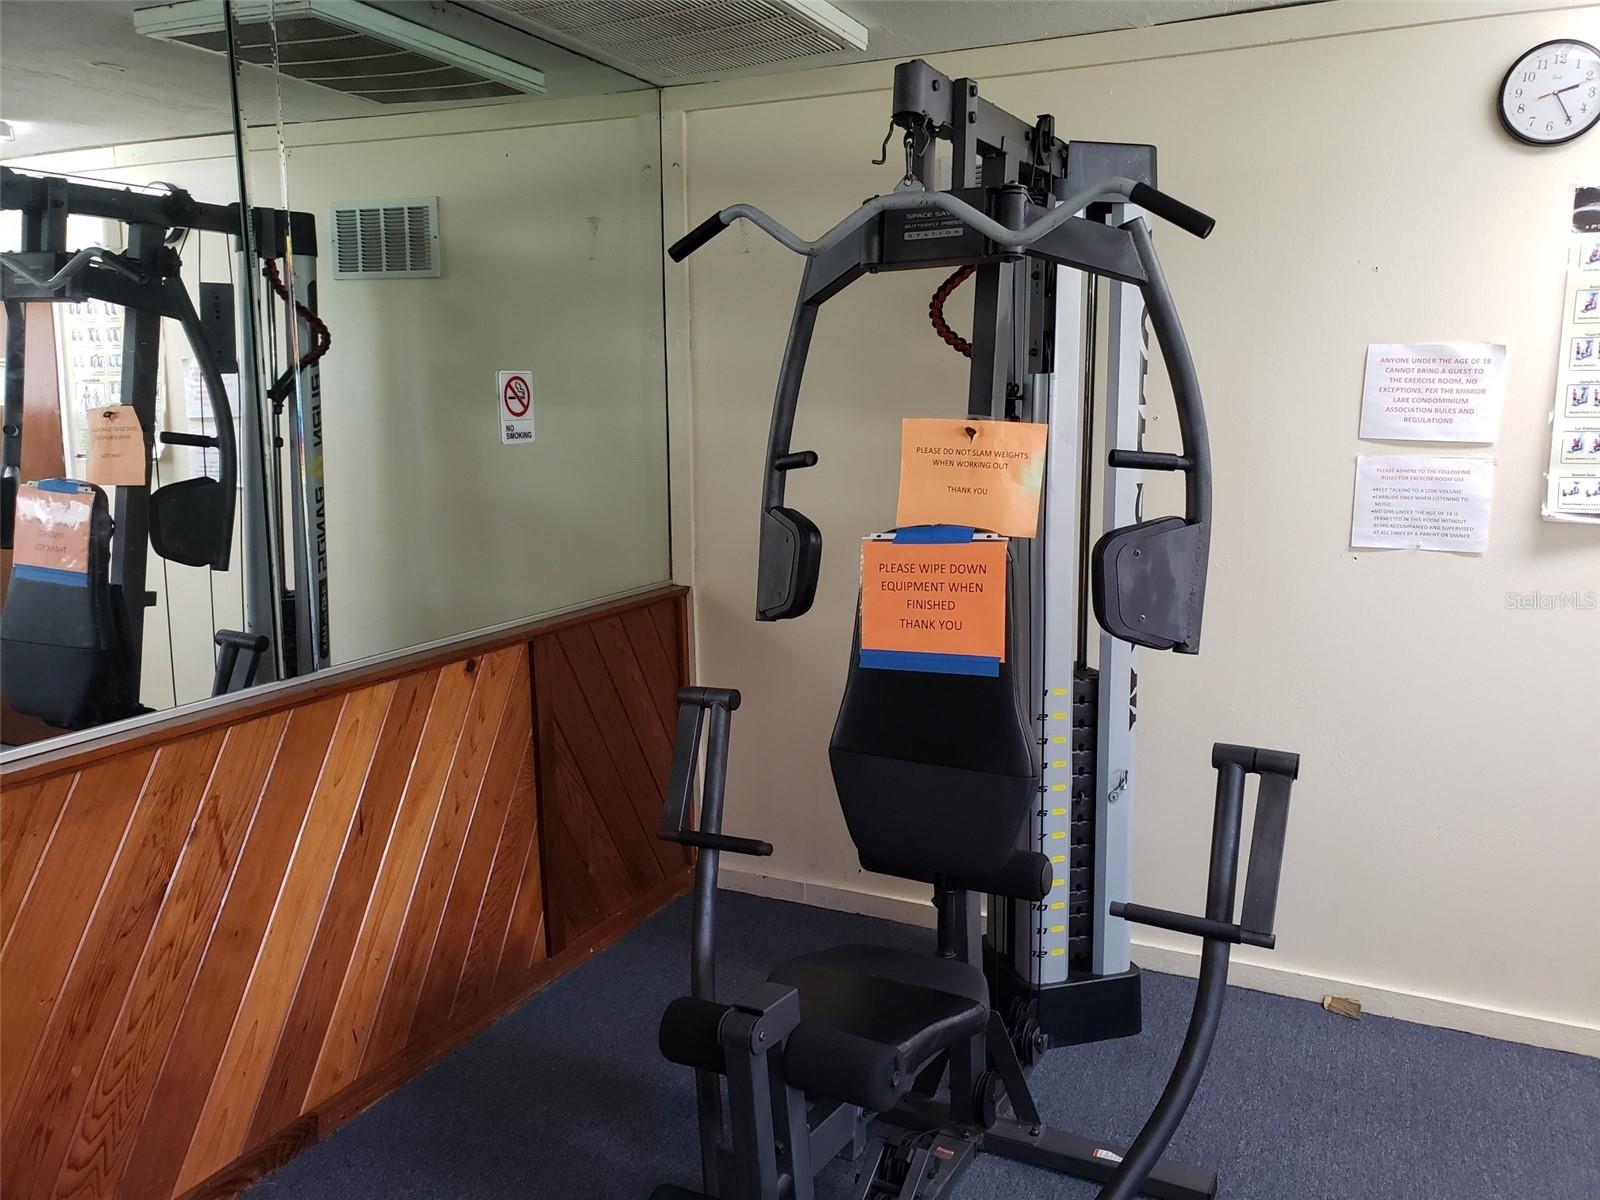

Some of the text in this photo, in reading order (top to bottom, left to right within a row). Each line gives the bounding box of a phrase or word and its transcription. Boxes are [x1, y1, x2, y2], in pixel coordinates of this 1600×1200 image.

[1554, 54, 1567, 64] 12
[1576, 59, 1580, 69] 1
[1538, 60, 1547, 69] 11
[1523, 72, 1535, 82] 10
[1586, 70, 1593, 80] 2
[1515, 88, 1522, 98] 9
[1588, 87, 1596, 97] 3
[1517, 104, 1525, 114] 8
[1580, 103, 1587, 113] 4
[1529, 117, 1536, 127] 7
[1546, 121, 1553, 131] 6
[1565, 116, 1572, 126] 5
[908, 230, 959, 238] STATION
[994, 451, 1028, 459] WEIGHTS
[956, 461, 990, 469] WORKING
[993, 462, 1008, 470] OUT
[947, 486, 971, 494] THANK
[879, 564, 986, 574] PLEASE WIPE DOWN
[881, 581, 983, 592] EQUIPMENT WHEN
[907, 600, 955, 610] FINISHED
[900, 619, 962, 630] THANK YOU
[1031, 950, 1047, 958] 12
